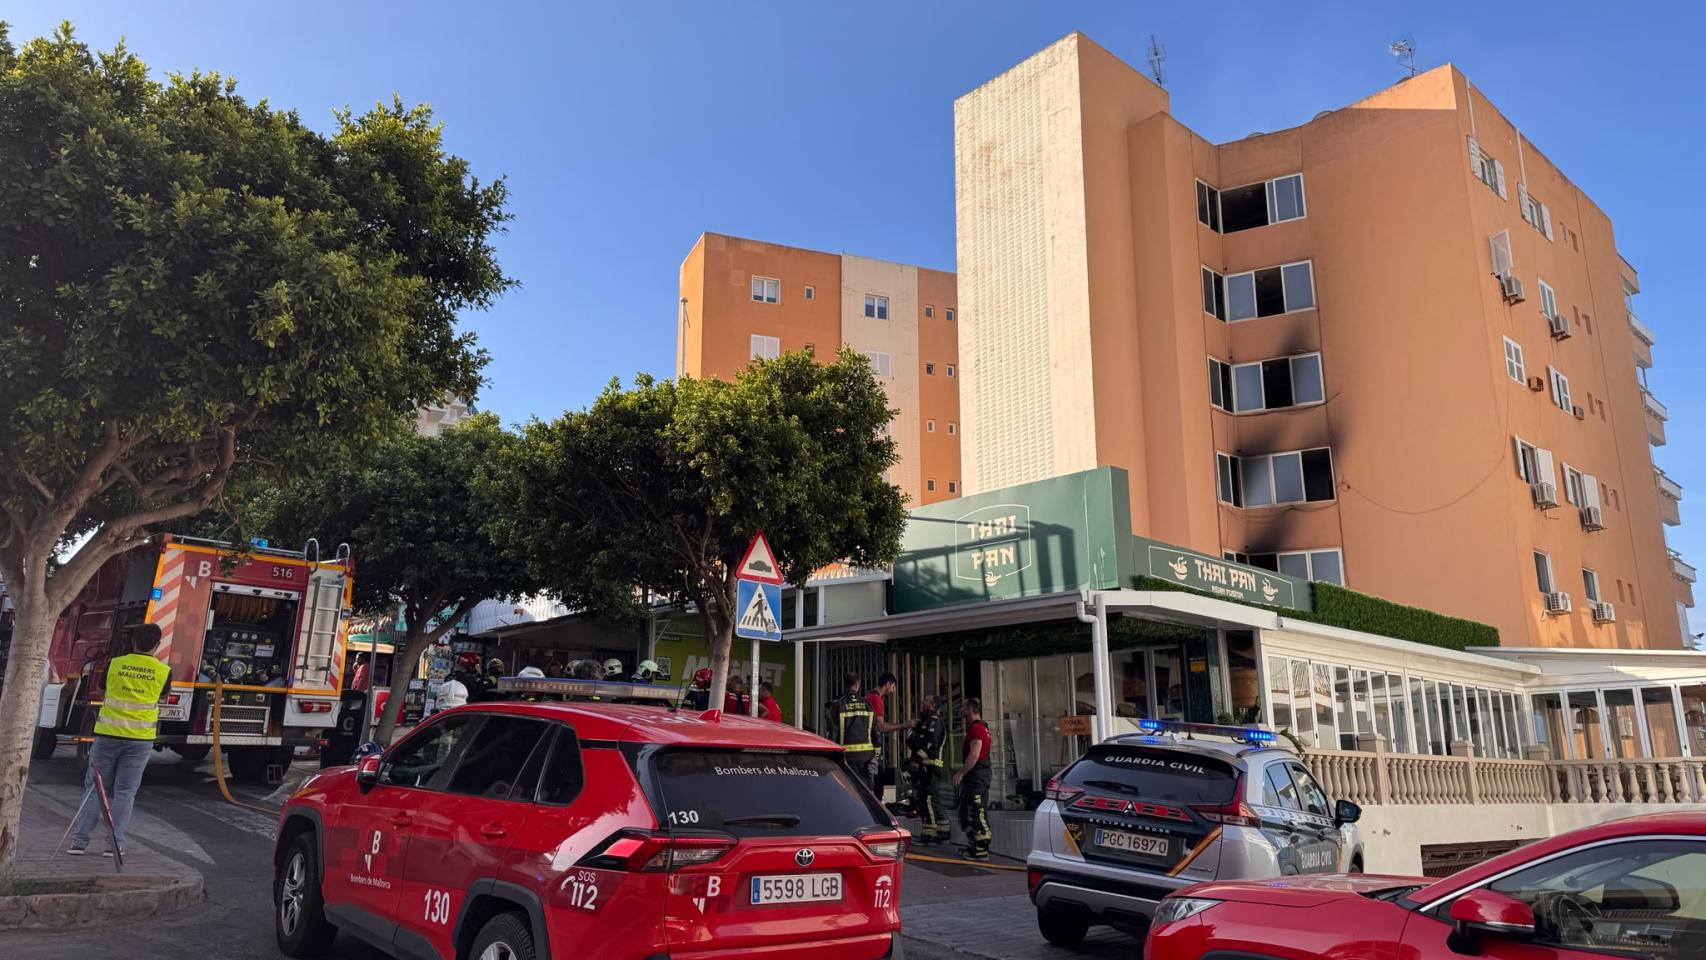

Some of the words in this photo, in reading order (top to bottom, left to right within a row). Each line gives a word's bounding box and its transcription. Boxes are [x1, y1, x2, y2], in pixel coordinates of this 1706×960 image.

[968, 514, 1017, 540] THAI
[971, 546, 1014, 570] PAN
[198, 560, 212, 577] B
[272, 566, 293, 579] 516
[1194, 558, 1227, 585] THAI
[1228, 567, 1256, 592] PAN
[117, 671, 156, 681] MALLORCA
[121, 664, 156, 675] BOMBERS
[121, 685, 145, 694] Premsa
[714, 765, 762, 776] Bombers
[763, 765, 777, 776] de
[777, 766, 819, 778] Mallorca
[1104, 755, 1166, 767] GUARDIA
[1169, 761, 1205, 774] CIVIL
[668, 810, 699, 825] 130
[371, 830, 381, 855] B
[1102, 832, 1124, 847] PGC
[1301, 851, 1320, 870] GUARDIA
[1320, 850, 1332, 867] CIVIL
[578, 870, 597, 883] SOS
[706, 875, 721, 897] B
[571, 882, 598, 910] 112
[763, 879, 805, 900] 5598
[811, 877, 839, 898] LGB
[424, 888, 450, 925] 130
[874, 889, 891, 908] 112
